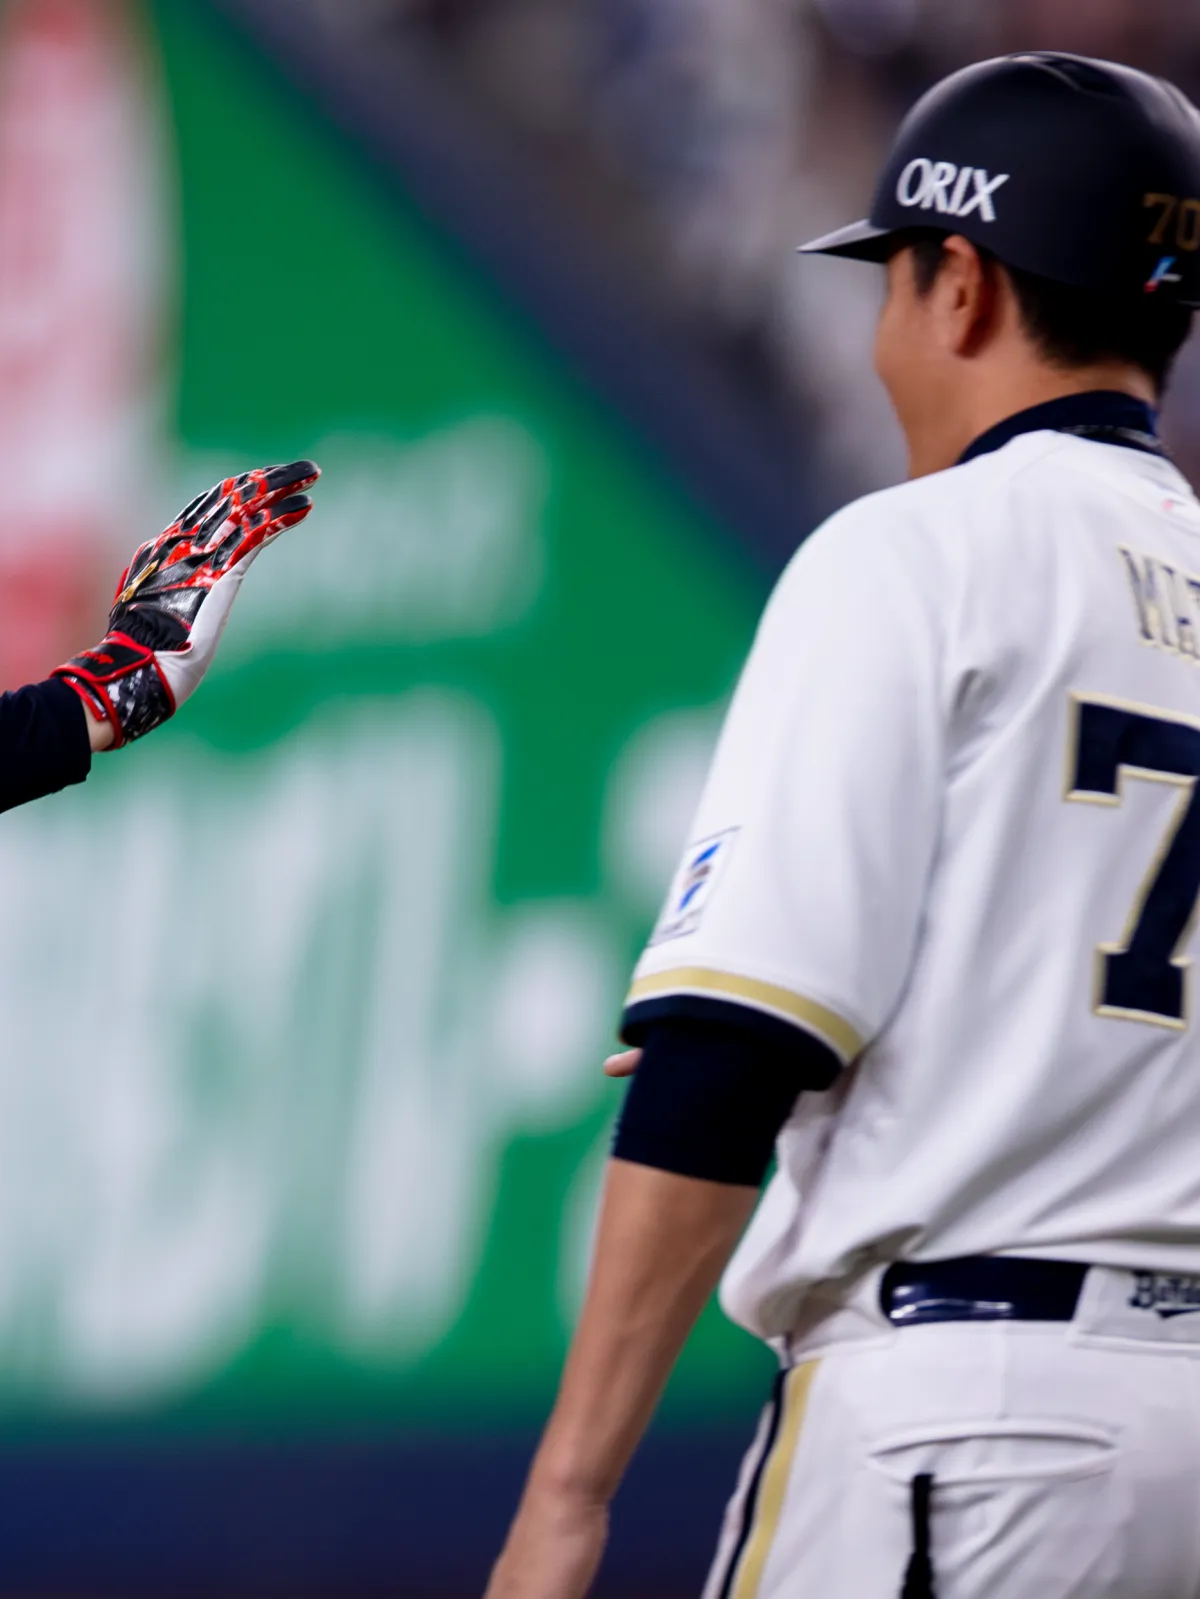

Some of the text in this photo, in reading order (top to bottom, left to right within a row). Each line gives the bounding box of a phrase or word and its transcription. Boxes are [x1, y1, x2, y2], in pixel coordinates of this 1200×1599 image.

[896, 157, 1010, 222] ORIX
[1143, 192, 1200, 250] 70
[1063, 690, 1200, 1031] 7
